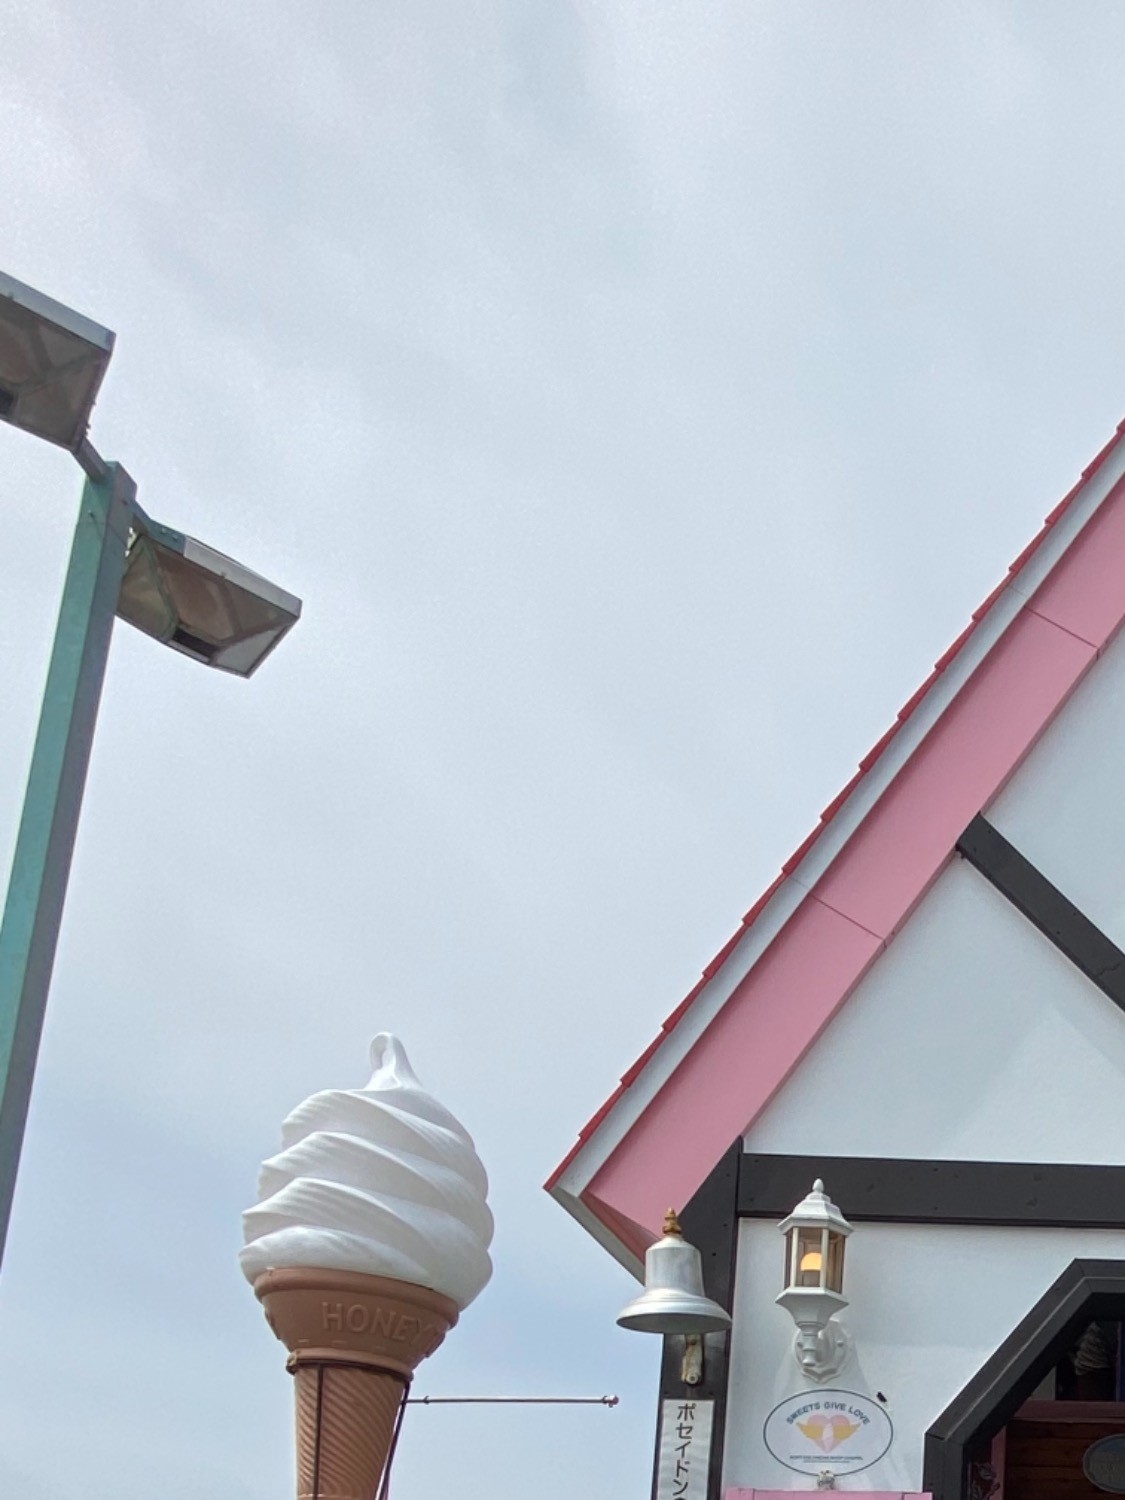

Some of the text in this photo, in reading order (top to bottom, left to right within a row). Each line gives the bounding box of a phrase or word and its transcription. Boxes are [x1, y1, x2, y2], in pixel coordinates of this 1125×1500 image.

[321, 1301, 433, 1345] HONEY
[786, 1401, 870, 1425] SWEETS GIVE LOVE
